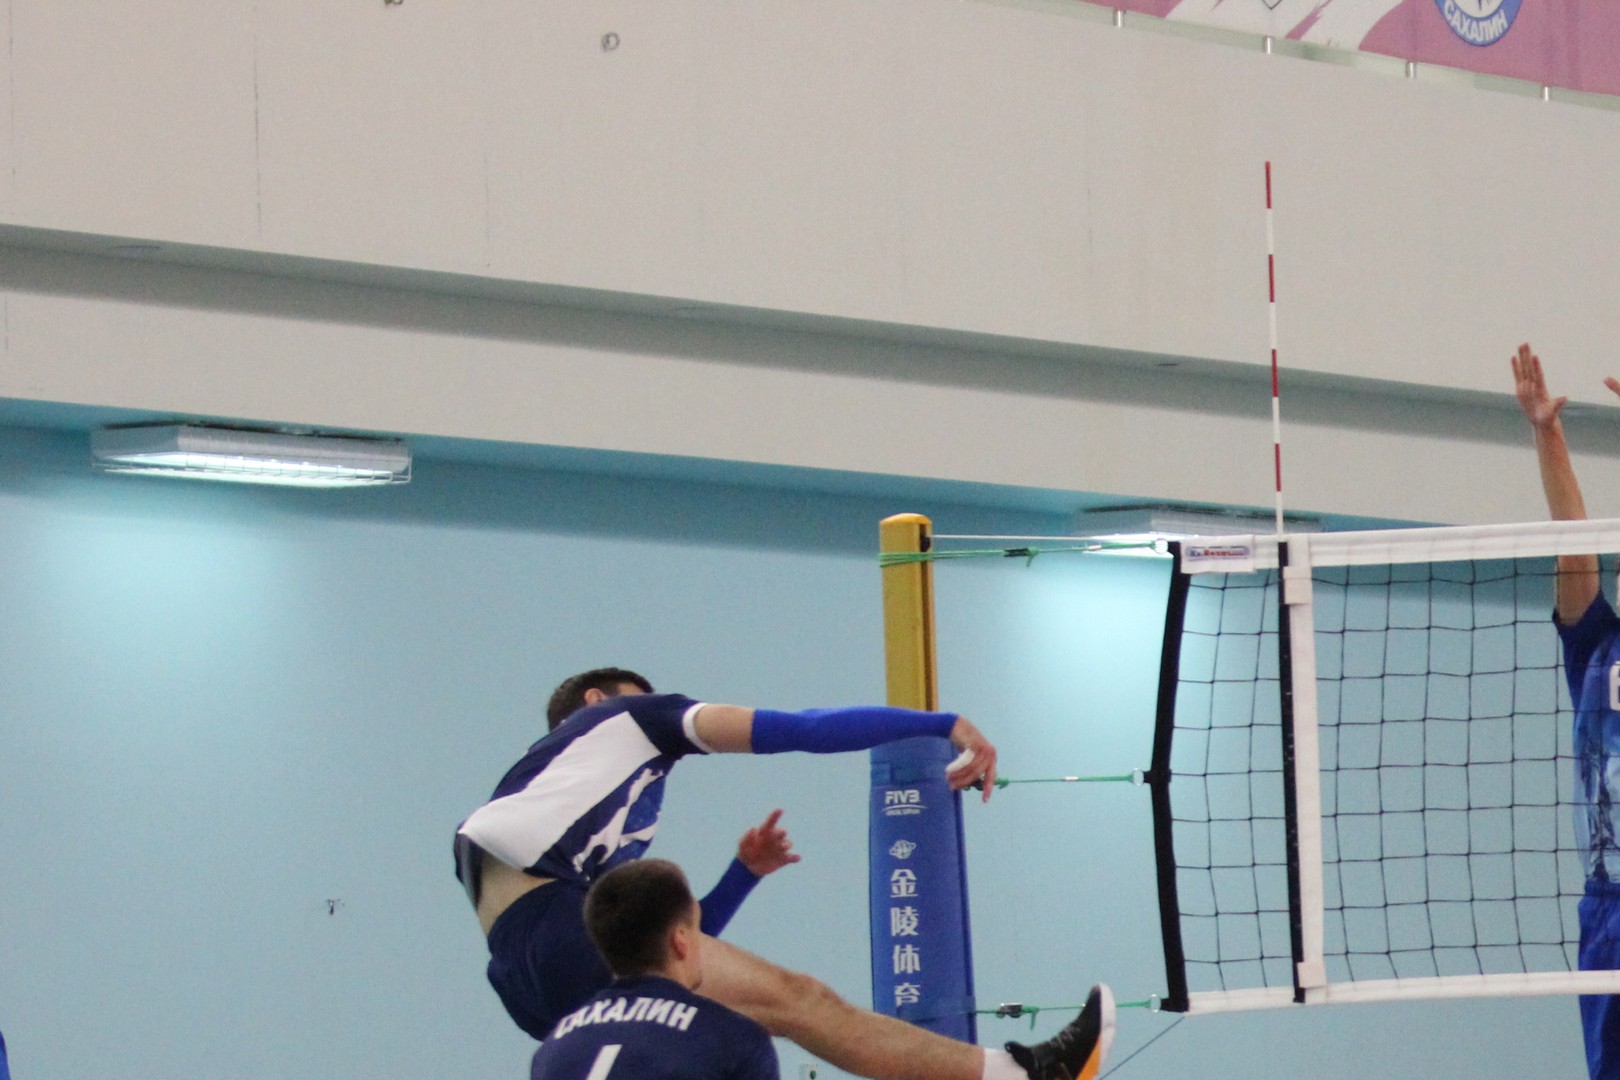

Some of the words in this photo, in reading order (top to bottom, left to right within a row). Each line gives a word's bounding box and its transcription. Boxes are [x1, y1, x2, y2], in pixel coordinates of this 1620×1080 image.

[885, 789, 920, 805] FIVB
[889, 868, 922, 1008] 金陵体育
[554, 996, 699, 1041] САХАЛИН
